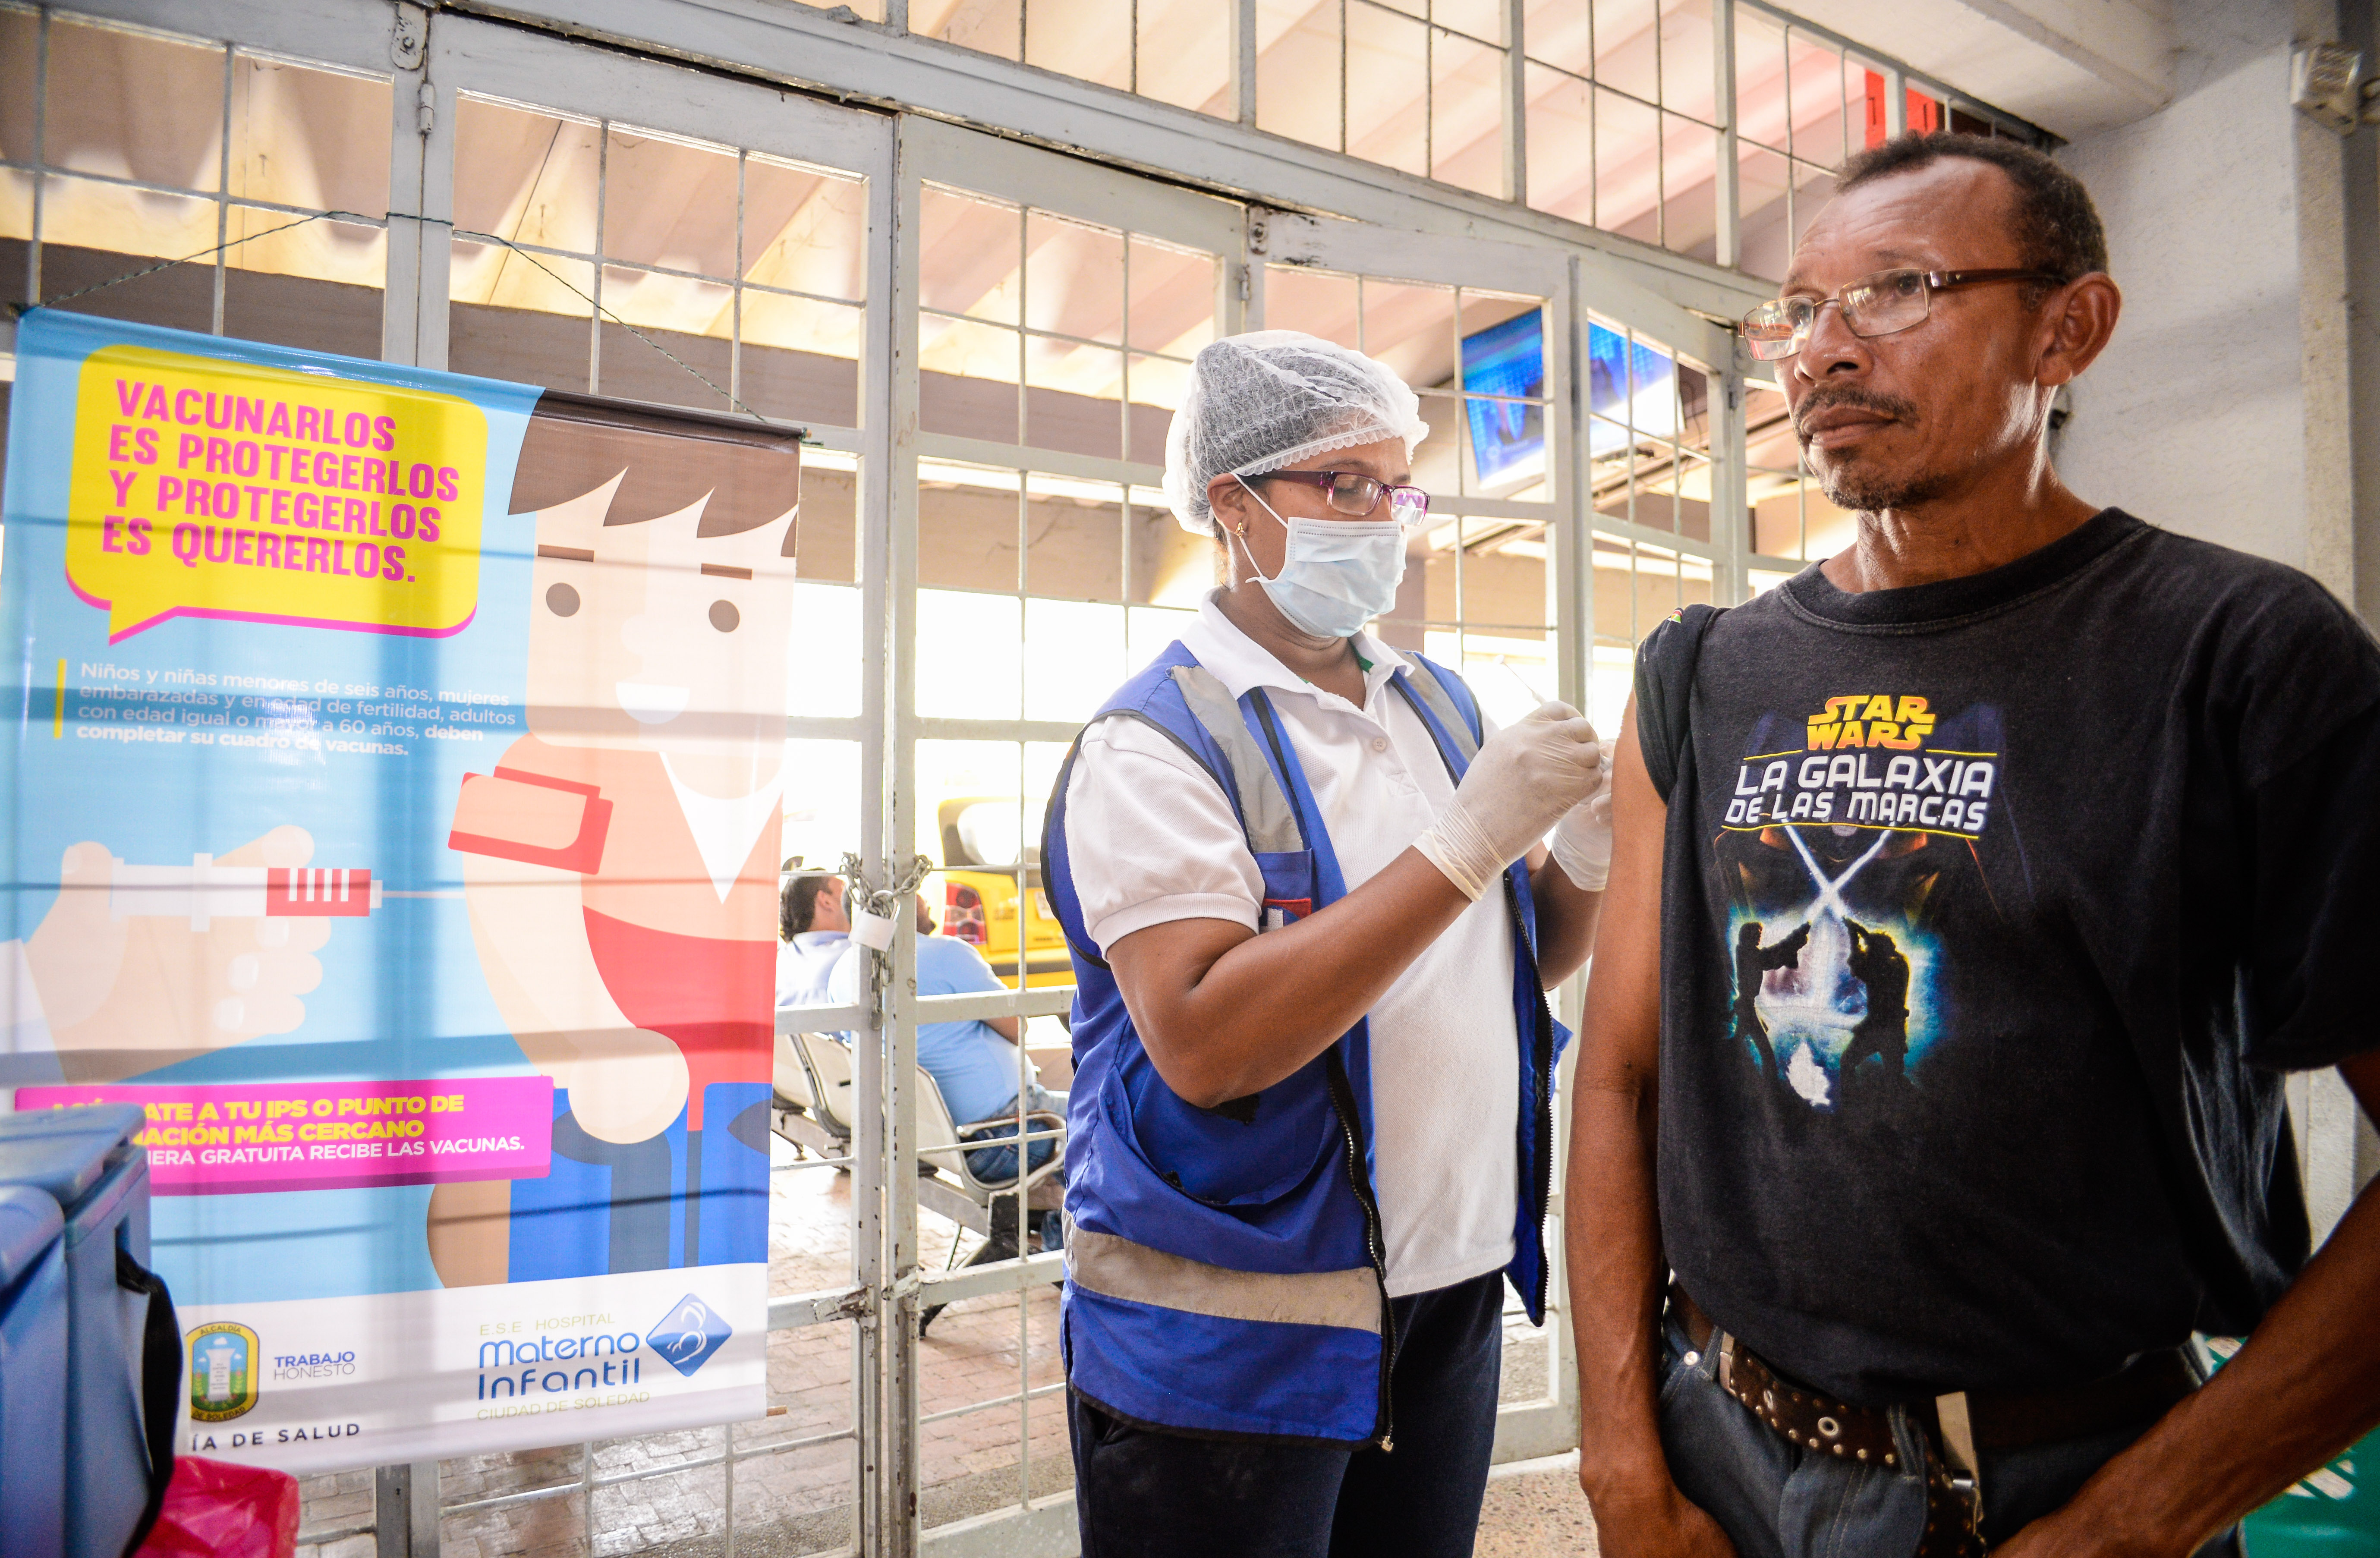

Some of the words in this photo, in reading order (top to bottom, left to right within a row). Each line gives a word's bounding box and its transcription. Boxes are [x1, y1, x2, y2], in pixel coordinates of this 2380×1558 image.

[115, 379, 396, 451] VACUNARLOS
[109, 424, 159, 465] ES
[178, 434, 459, 502] PROTEGERLOS
[109, 470, 136, 507] Y
[157, 475, 441, 542] PROTEGERLOS
[102, 516, 152, 556] ES
[172, 523, 415, 582] QUERERLOS.
[82, 663, 140, 680] Niños
[147, 670, 158, 684] y
[165, 669, 217, 686] niñas
[224, 674, 309, 692] menores
[315, 679, 339, 694] de
[344, 682, 379, 697] seis
[385, 685, 433, 702] años,
[438, 690, 509, 706] mujeres
[79, 685, 218, 705] embarazadas
[224, 695, 235, 708] y
[242, 696, 265, 708] en
[327, 699, 351, 714] de
[357, 701, 444, 722] fertilidad,
[450, 708, 515, 724] adultos
[1808, 695, 1936, 726] STAR
[79, 707, 116, 719] con
[123, 707, 175, 723] edad
[182, 708, 230, 727] igual
[236, 716, 249, 727] o
[323, 721, 334, 732] a
[340, 719, 365, 734] 60
[371, 722, 419, 739] años,
[425, 725, 483, 742] deben
[1807, 720, 1933, 750] WARS
[77, 726, 186, 743] completar
[190, 732, 214, 745] su
[219, 733, 290, 749] cuadro
[295, 733, 319, 750] de
[326, 738, 409, 755] vacunas.
[1735, 760, 1788, 795] LA
[1798, 753, 1994, 798] GALAXIA
[1725, 796, 1763, 823] DE
[1771, 792, 1834, 820] LAS
[1846, 791, 1986, 831] MARCAS
[198, 1102, 220, 1120] A
[224, 1101, 261, 1119] TU
[267, 1100, 308, 1118] IPS
[313, 1099, 334, 1117] O
[338, 1096, 426, 1116] PUNTO
[431, 1095, 464, 1113] DE
[234, 1121, 294, 1144] MÁS
[299, 1120, 424, 1141] CERCANO
[201, 1146, 305, 1164] GRATUITA
[310, 1143, 382, 1160] RECIBE
[387, 1141, 425, 1157] LAS
[430, 1136, 525, 1154] VACUNAS.
[201, 1325, 242, 1335] ALCALDÍA
[480, 1321, 522, 1336] E.S.E
[536, 1313, 615, 1330] HOSPITAL
[274, 1351, 355, 1367] TRABAJO
[274, 1363, 355, 1380] HONESTO
[479, 1357, 639, 1400] Infantil
[477, 1403, 541, 1420] CIUDAD
[546, 1400, 569, 1413] DE
[574, 1391, 650, 1410] SOLEDAD
[233, 1431, 264, 1447] DE
[278, 1423, 360, 1442] SALUD
